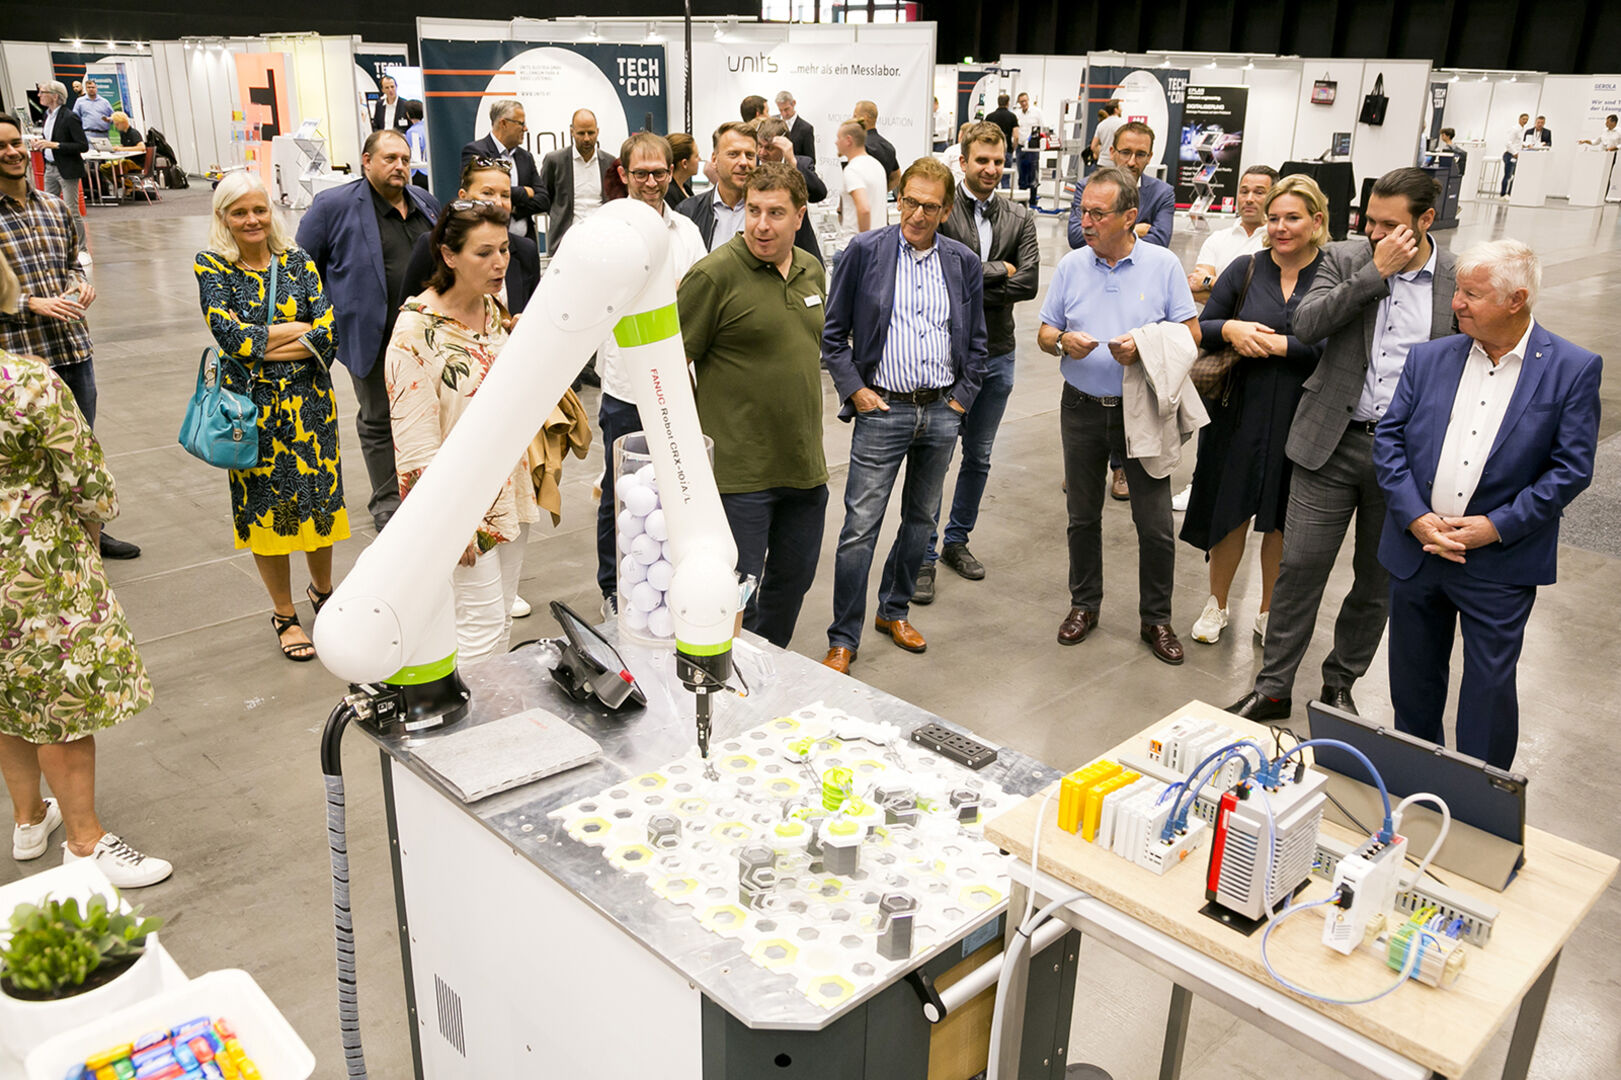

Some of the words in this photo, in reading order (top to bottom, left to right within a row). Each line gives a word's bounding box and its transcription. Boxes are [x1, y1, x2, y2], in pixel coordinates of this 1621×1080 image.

[617, 58, 659, 77] TECH
[728, 52, 778, 73] units
[821, 64, 833, 75] als
[835, 64, 849, 75] ein
[850, 64, 901, 77] Messlabor.
[651, 368, 666, 405] FANUC
[661, 407, 674, 440] Robot
